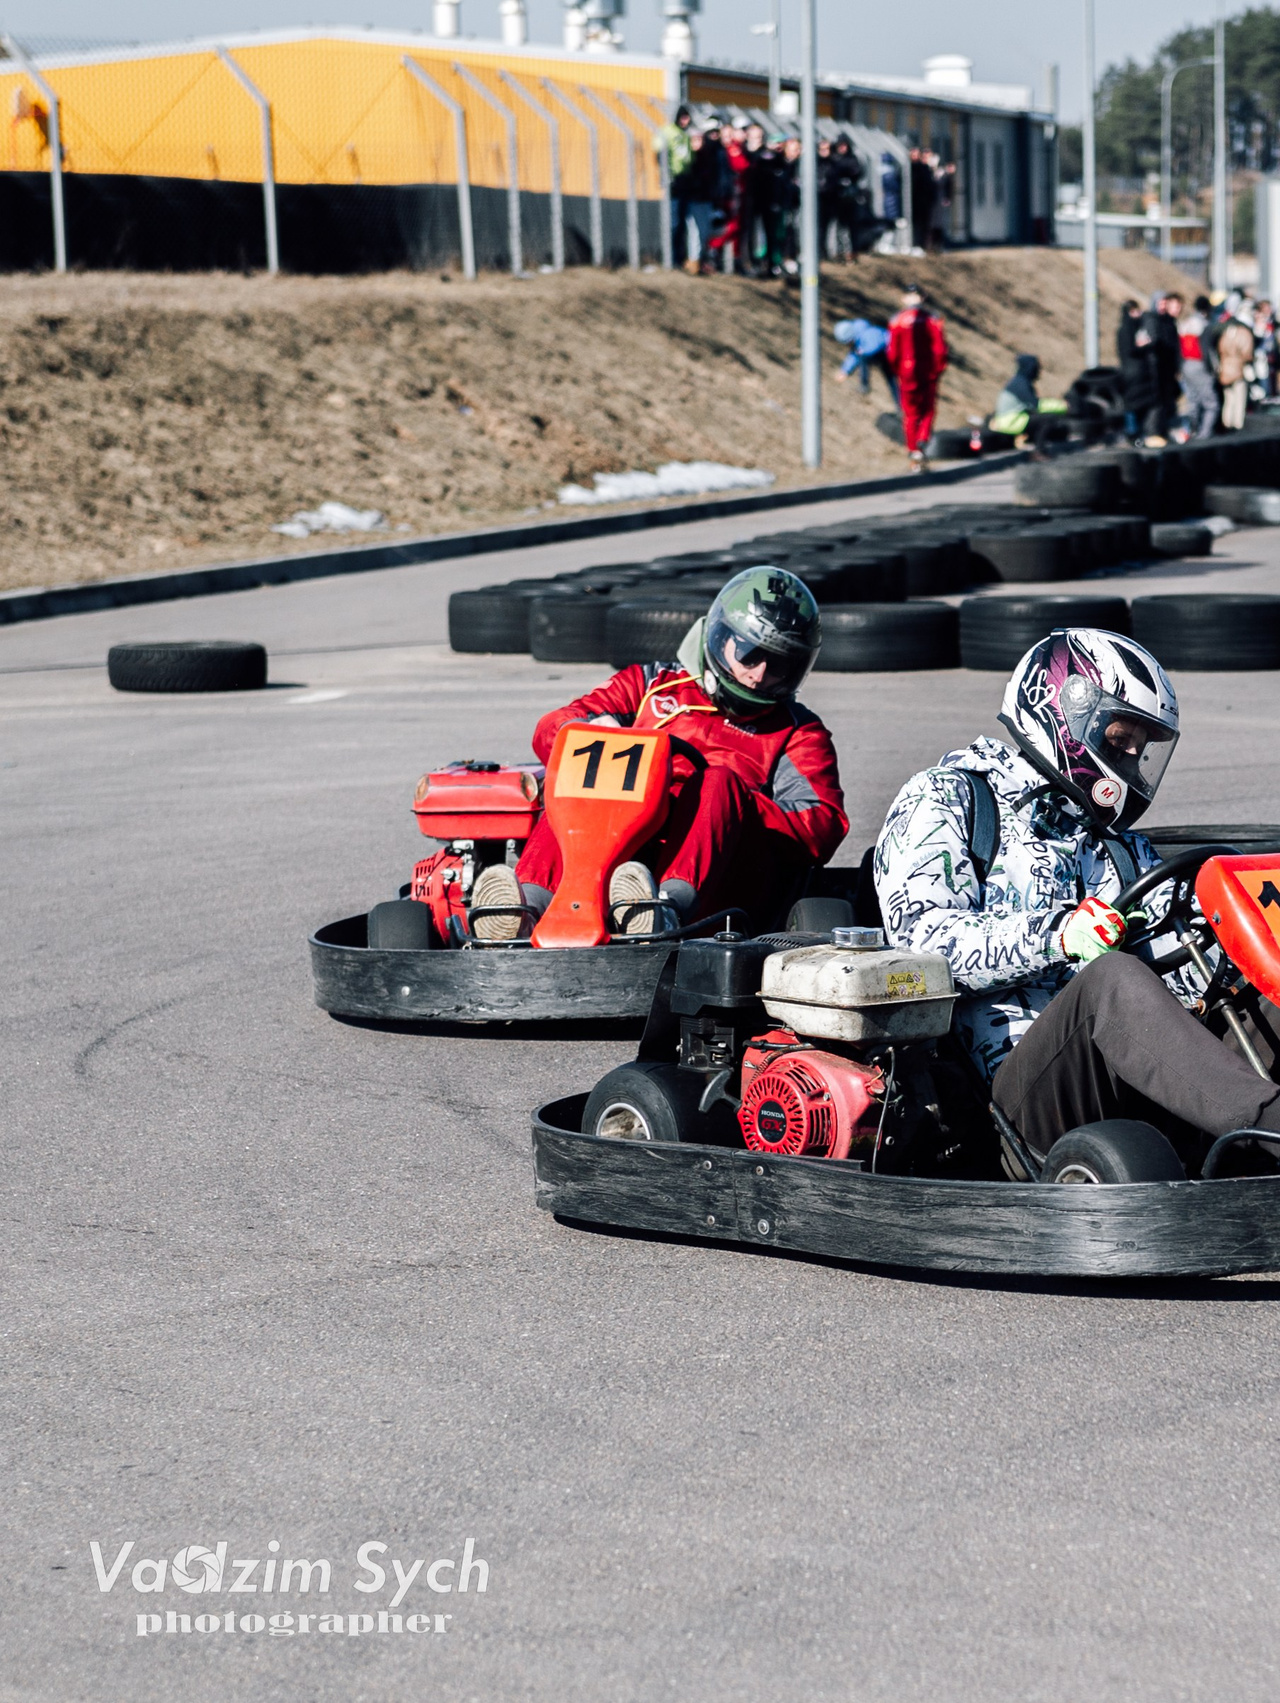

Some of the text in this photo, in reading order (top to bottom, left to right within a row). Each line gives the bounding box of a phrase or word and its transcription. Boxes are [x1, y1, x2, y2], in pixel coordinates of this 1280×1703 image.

[1160, 702, 1179, 718] LS
[572, 740, 645, 792] 11
[761, 1109, 785, 1119] HONDA
